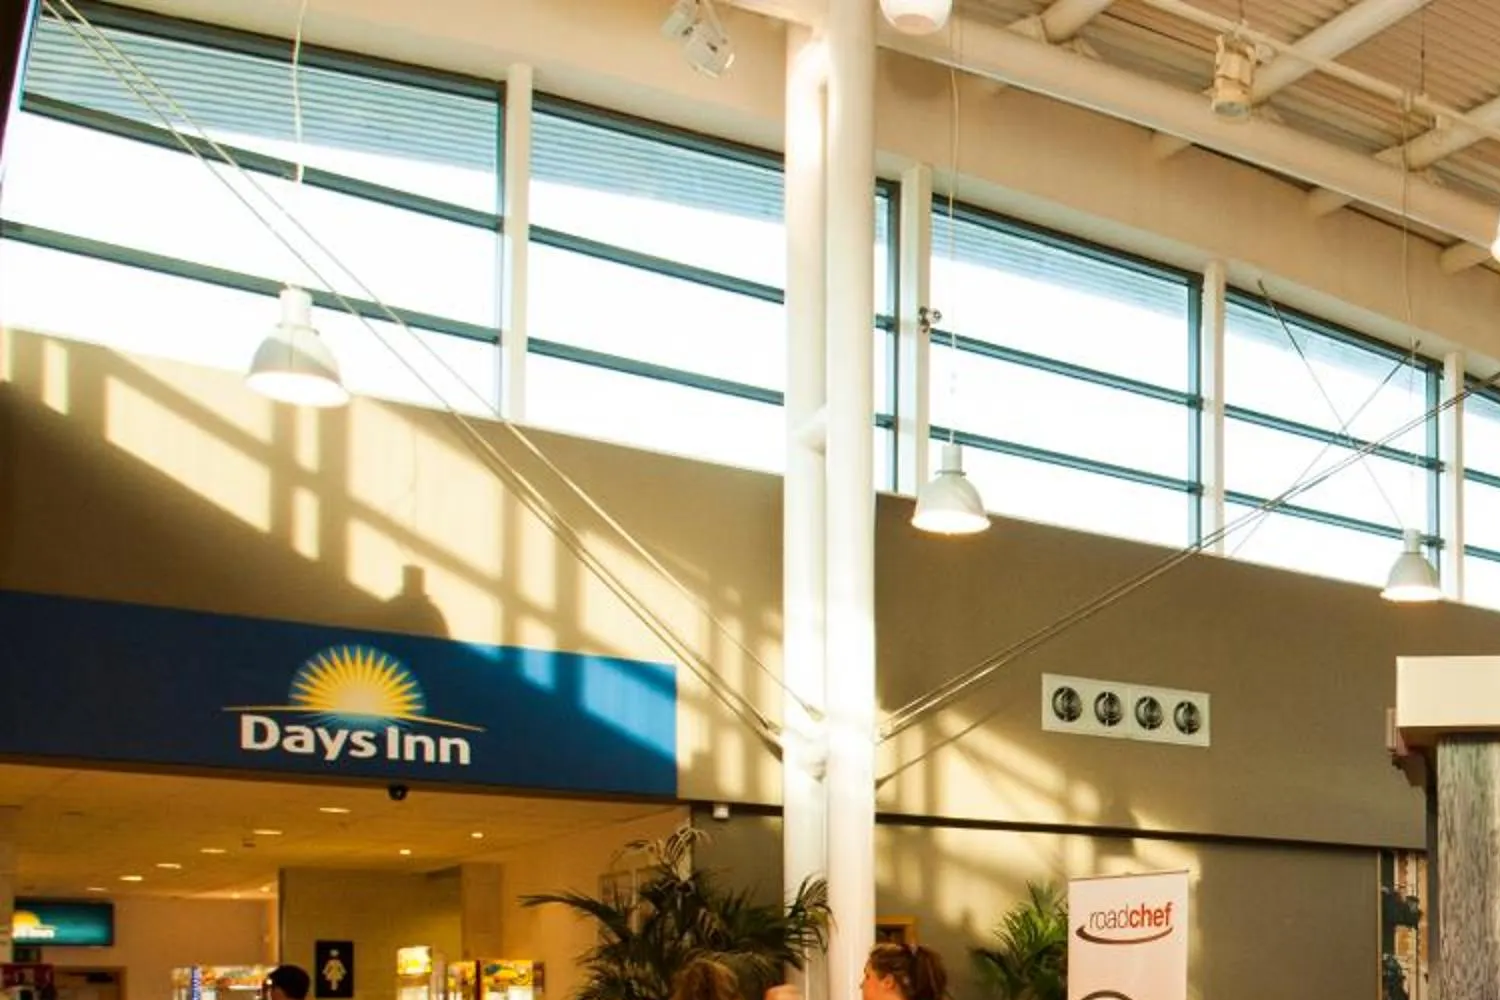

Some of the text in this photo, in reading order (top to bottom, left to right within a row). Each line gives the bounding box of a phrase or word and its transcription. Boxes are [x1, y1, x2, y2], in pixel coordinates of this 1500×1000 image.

[240, 714, 470, 765] Days Inn
[1089, 902, 1172, 929] roadchef
